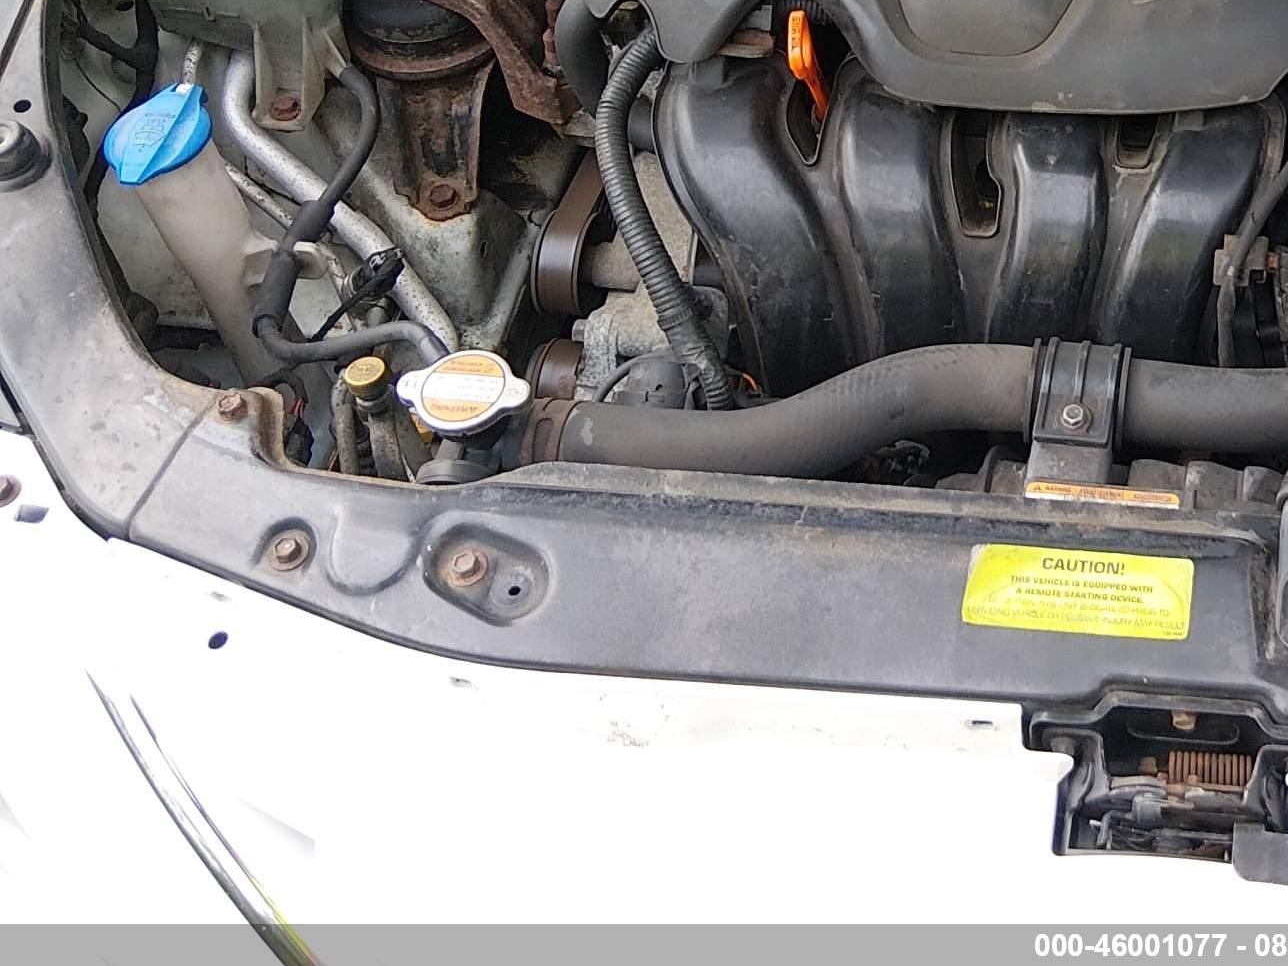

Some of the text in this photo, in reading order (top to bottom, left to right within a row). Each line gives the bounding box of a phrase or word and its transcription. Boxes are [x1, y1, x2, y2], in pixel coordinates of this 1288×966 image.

[1042, 557, 1125, 575] CAUTION!
[1010, 575, 1031, 583] THIS
[1033, 577, 1069, 586] VEHICLE
[1083, 581, 1127, 590] EQUIPPED
[1130, 584, 1153, 593] WITH
[1025, 588, 1062, 597] REMOTE
[1064, 591, 1108, 601] STARTING
